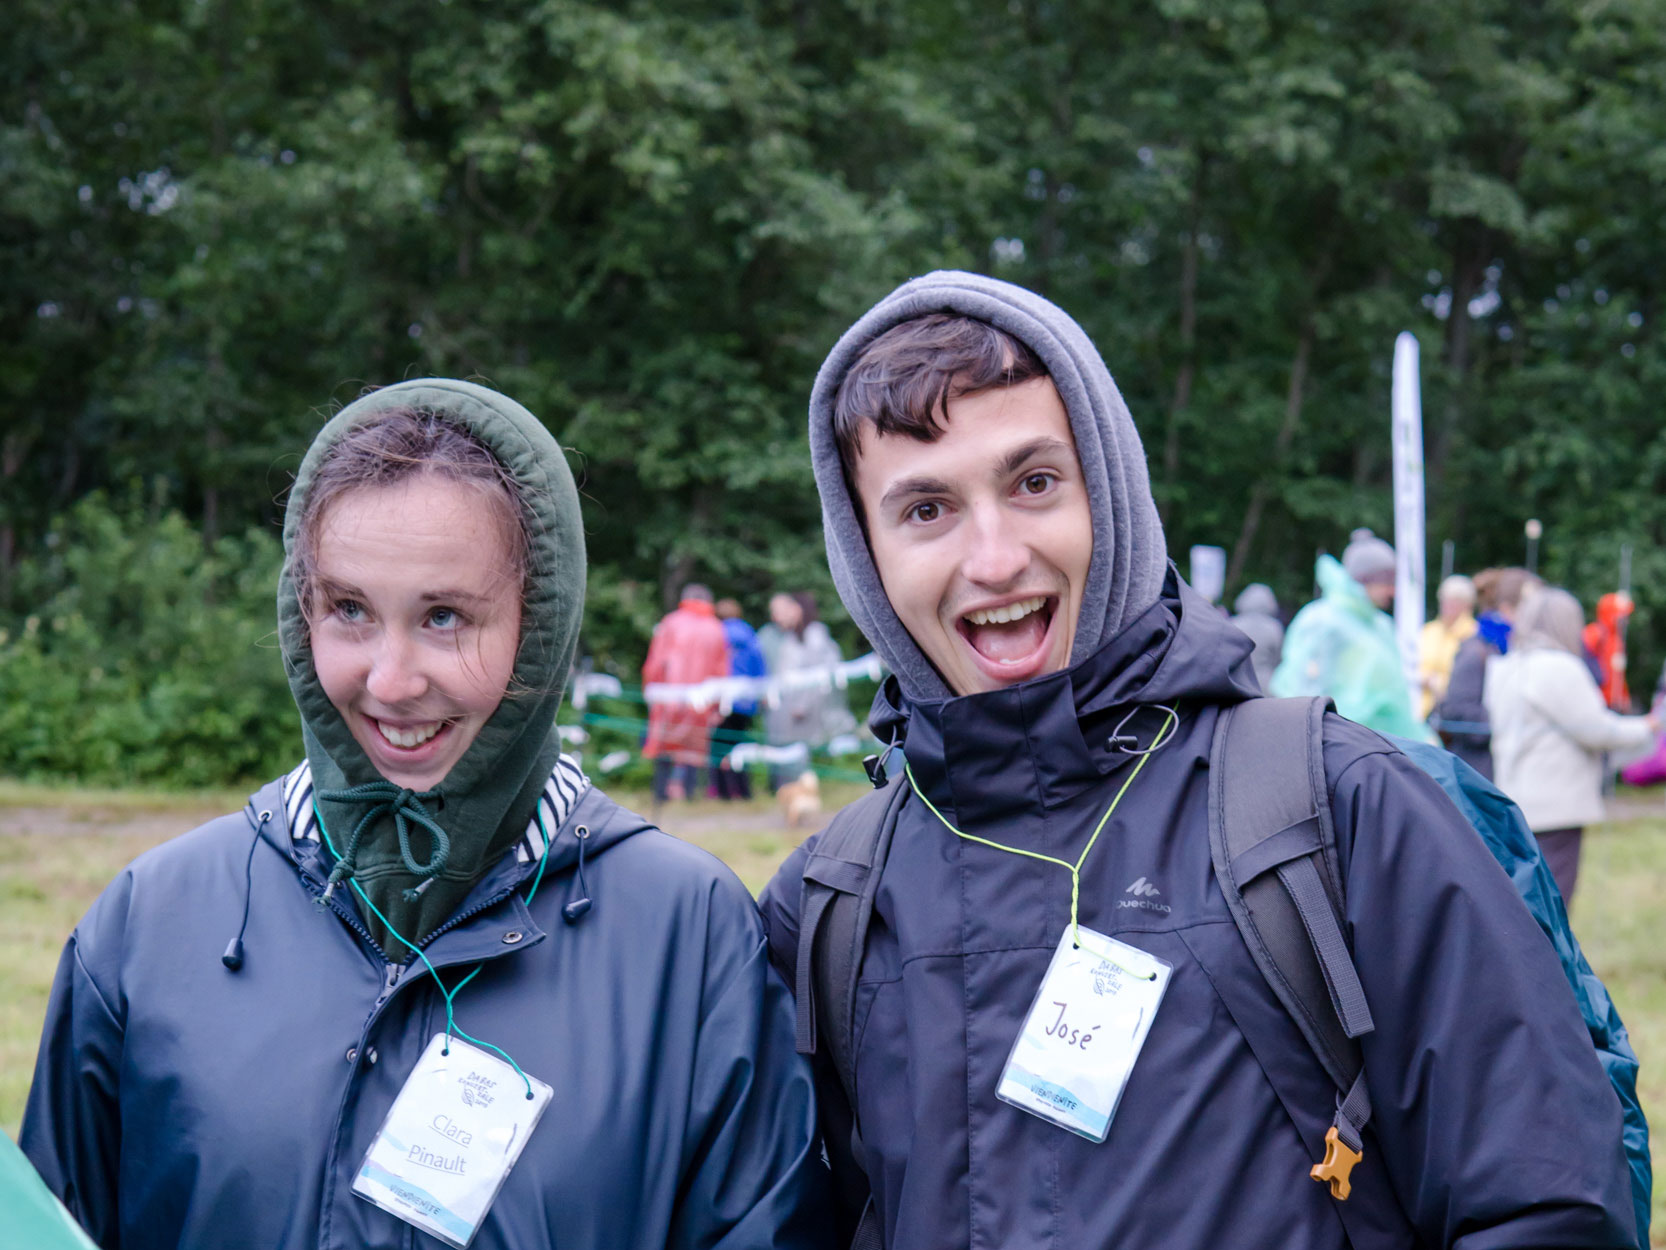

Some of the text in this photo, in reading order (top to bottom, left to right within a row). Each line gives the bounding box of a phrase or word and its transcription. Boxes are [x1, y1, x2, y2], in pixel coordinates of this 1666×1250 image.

[1045, 1001, 1101, 1050] José
[432, 1113, 473, 1146] Clara
[408, 1144, 467, 1173] Pinault
